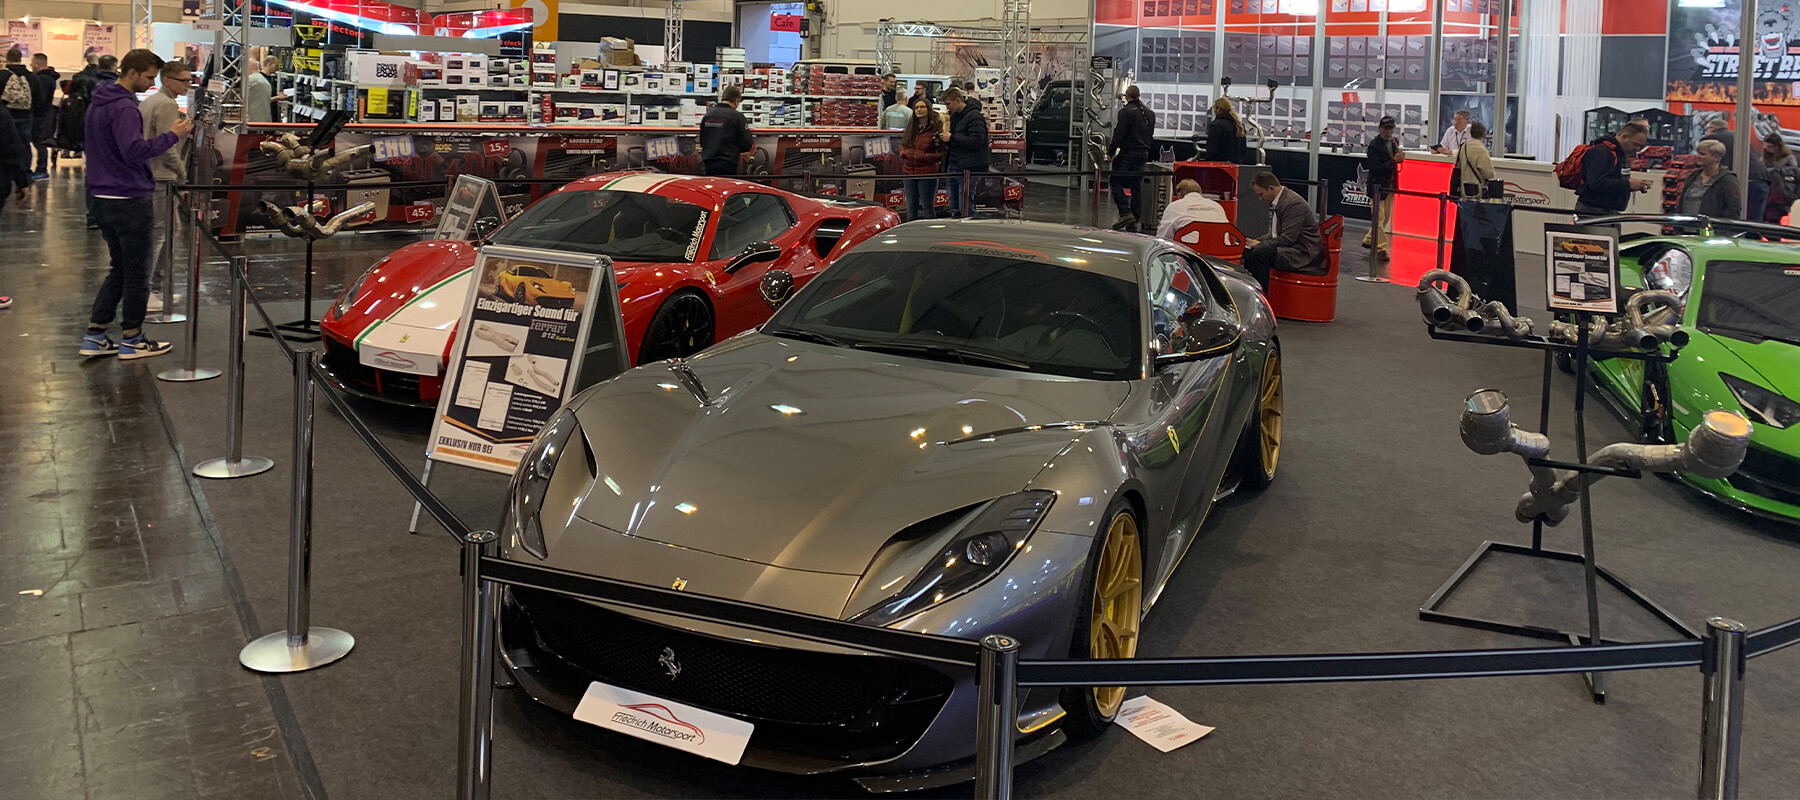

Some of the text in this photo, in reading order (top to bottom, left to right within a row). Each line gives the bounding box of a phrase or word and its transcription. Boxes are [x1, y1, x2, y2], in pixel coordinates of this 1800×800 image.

[774, 17, 794, 28] Cafe
[1702, 54, 1779, 78] STRET
[489, 142, 509, 153] 15,-
[1008, 188, 1020, 197] 15,-
[411, 208, 432, 218] 45,-
[476, 297, 579, 322] Einzigartiger Sound für
[530, 319, 568, 334] Ferrari
[541, 331, 556, 340] 812
[438, 436, 494, 454] EXKLUSIV NUR BEI
[611, 711, 696, 742] Friedrich Motorsport
